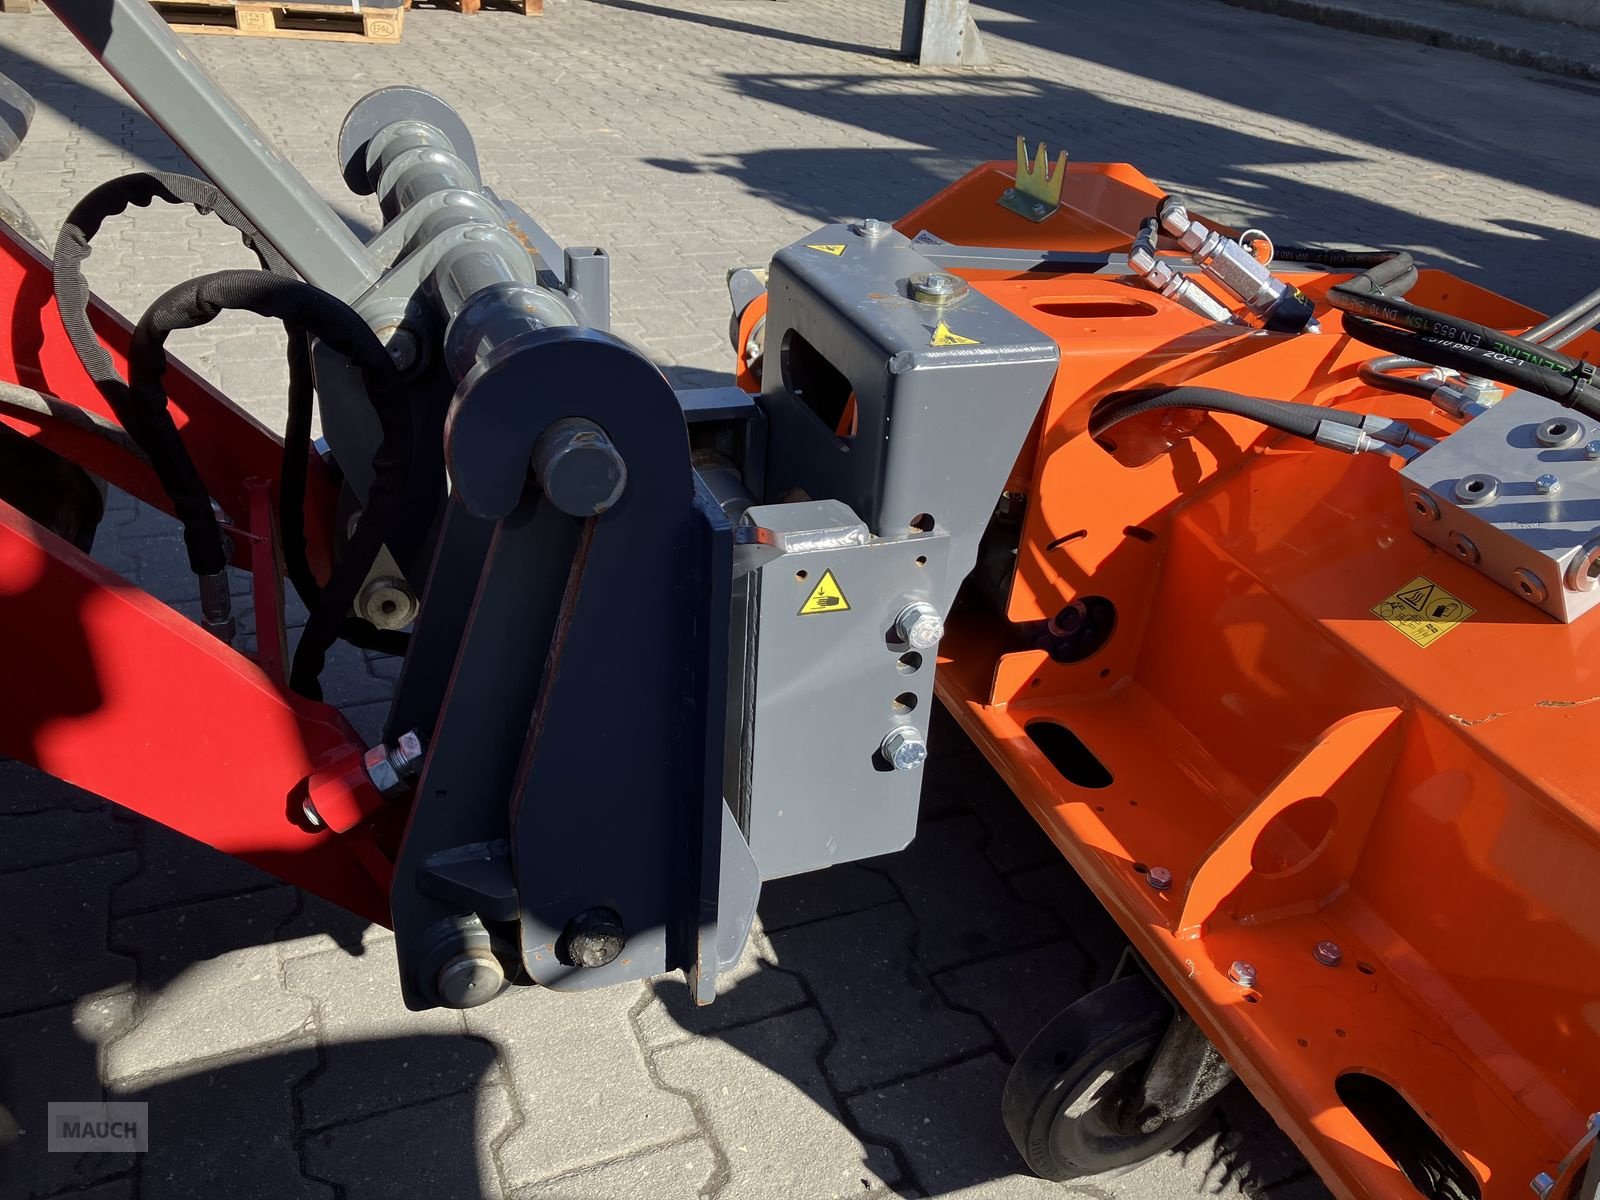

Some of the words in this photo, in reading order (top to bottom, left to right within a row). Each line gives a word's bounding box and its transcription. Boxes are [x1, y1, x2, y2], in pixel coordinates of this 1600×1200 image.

[373, 24, 391, 34] EPAL
[1382, 307, 1399, 320] DN
[1433, 322, 1457, 339] 853
[1460, 331, 1481, 347] EN
[1483, 350, 1525, 366] 2Q21
